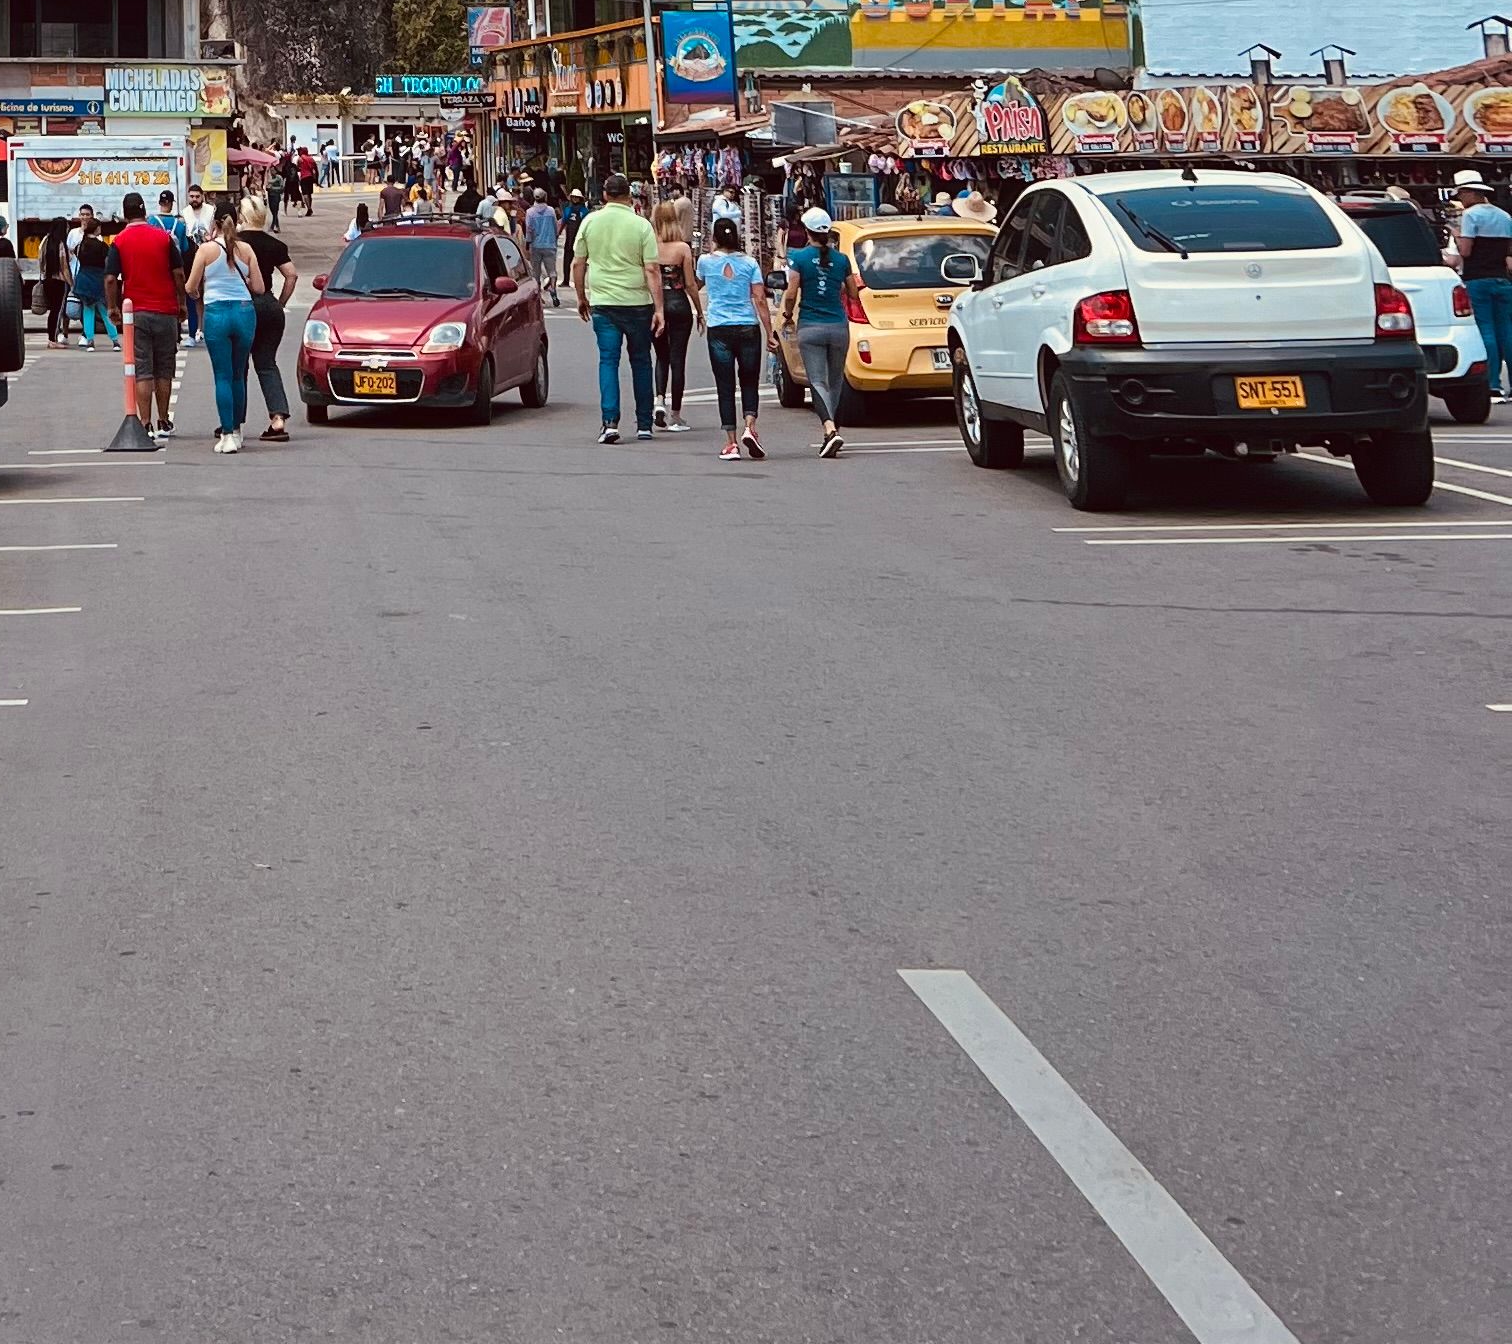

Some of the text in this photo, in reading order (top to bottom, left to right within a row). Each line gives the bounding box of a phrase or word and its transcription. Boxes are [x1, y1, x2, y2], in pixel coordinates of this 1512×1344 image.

[105, 68, 201, 90] MICHELADAS
[27, 101, 38, 112] de
[41, 101, 74, 113] turismo
[109, 91, 197, 113] CON MANGO
[525, 104, 541, 115] WC
[506, 117, 536, 127] Baños
[607, 133, 624, 143] WC
[981, 143, 1046, 154] RESTAURANTE
[78, 171, 102, 185] 315
[105, 171, 129, 185] 411
[908, 318, 947, 327] SERVICIO
